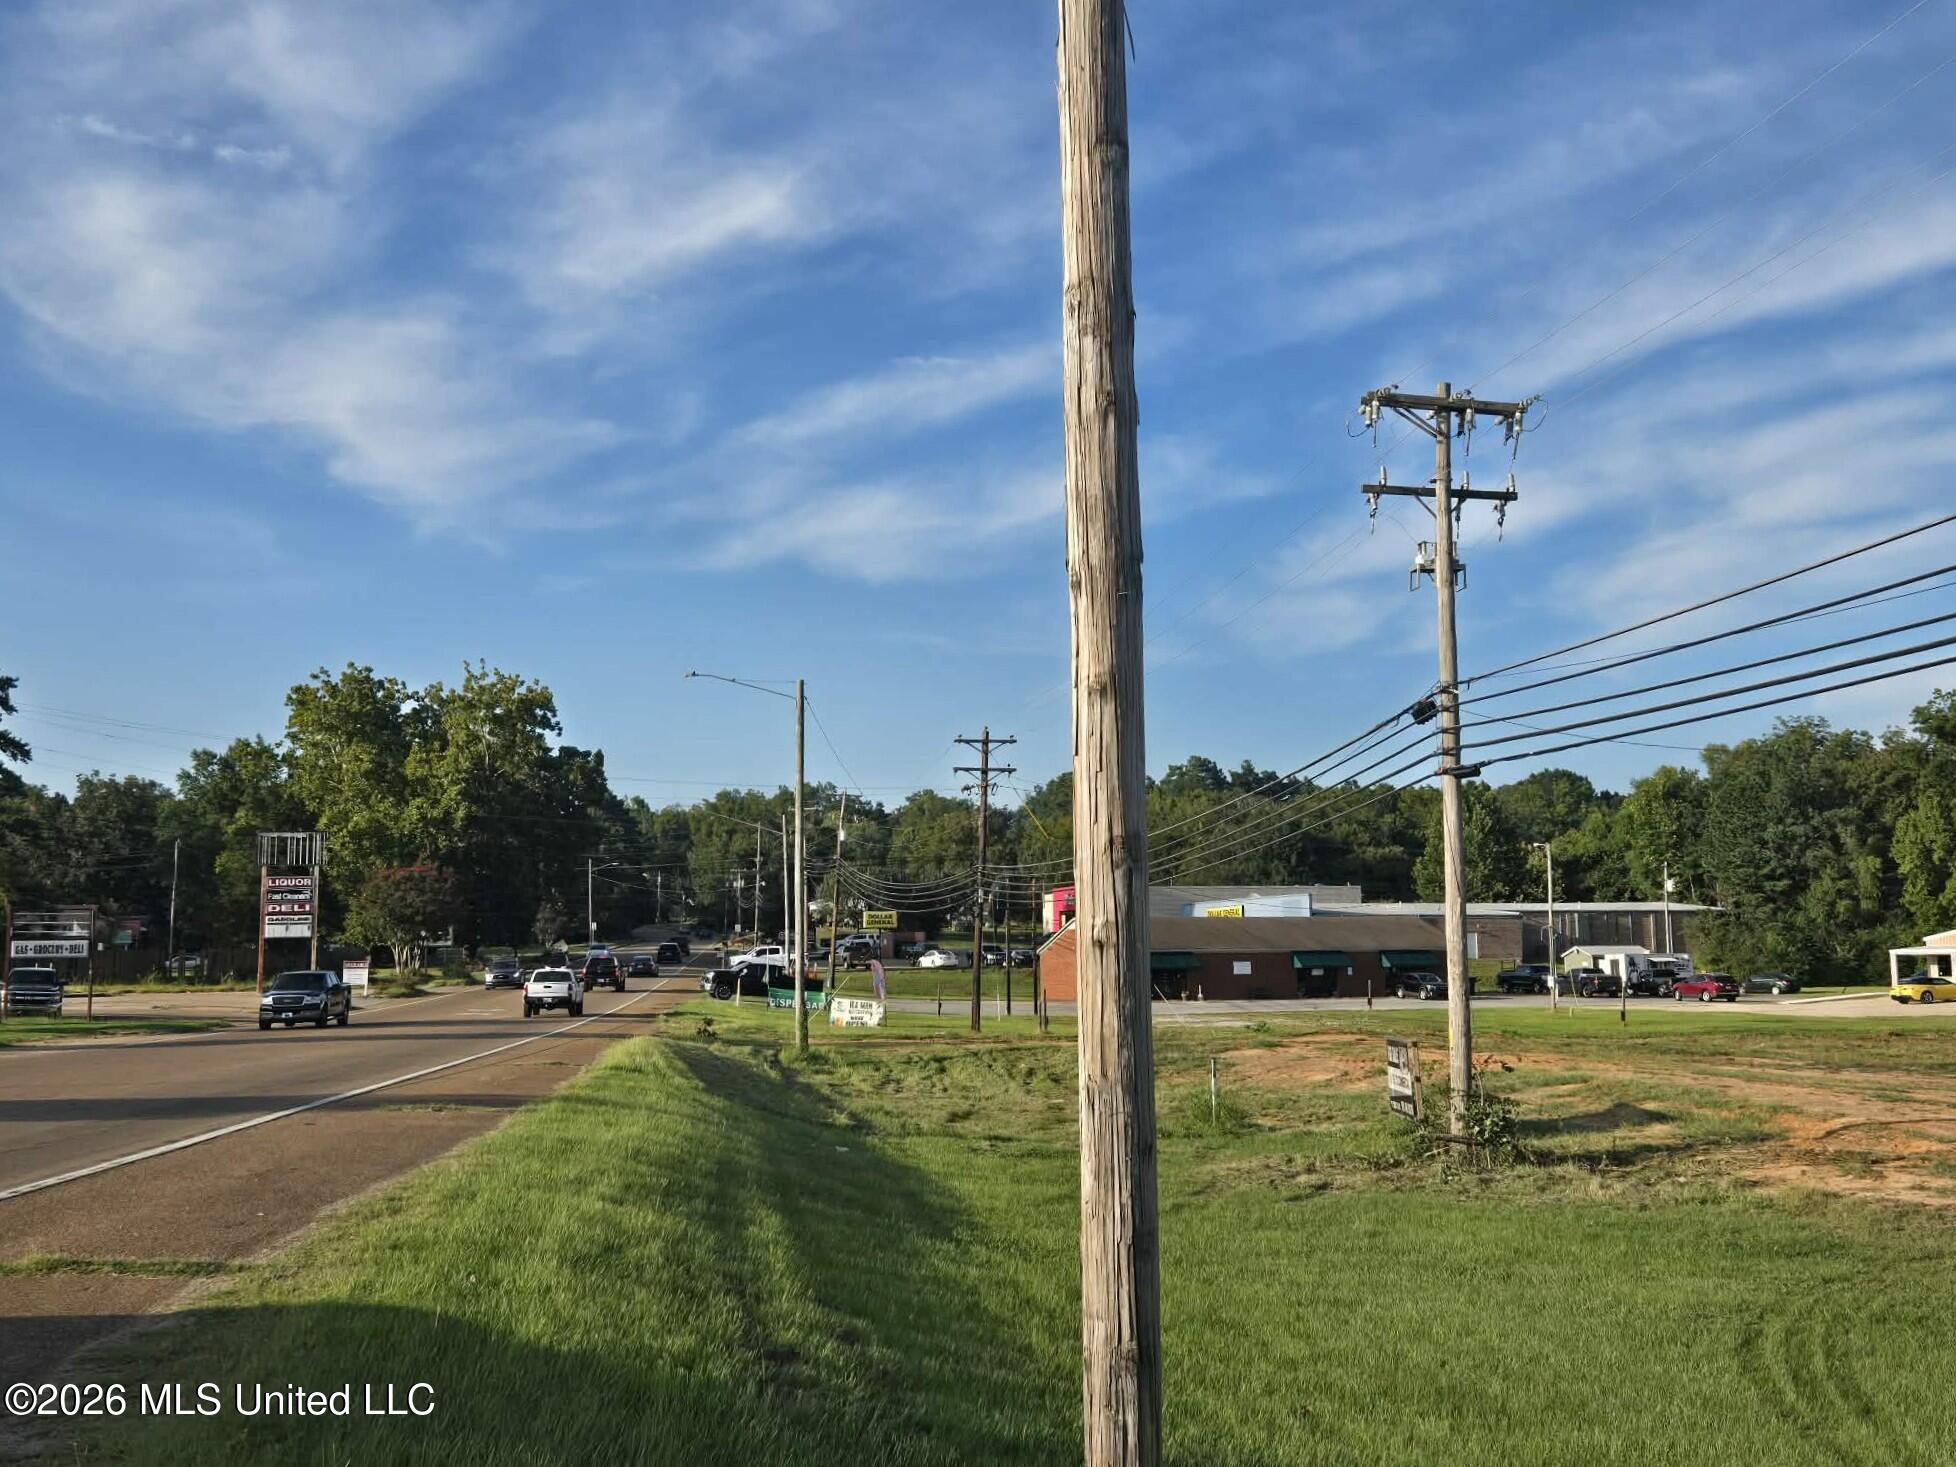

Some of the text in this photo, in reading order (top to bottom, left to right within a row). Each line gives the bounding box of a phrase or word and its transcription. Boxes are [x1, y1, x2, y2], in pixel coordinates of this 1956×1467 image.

[268, 878, 311, 886] LIQUOR
[268, 904, 310, 912] DELI
[15, 944, 84, 954] GAS GROCERY DELI
